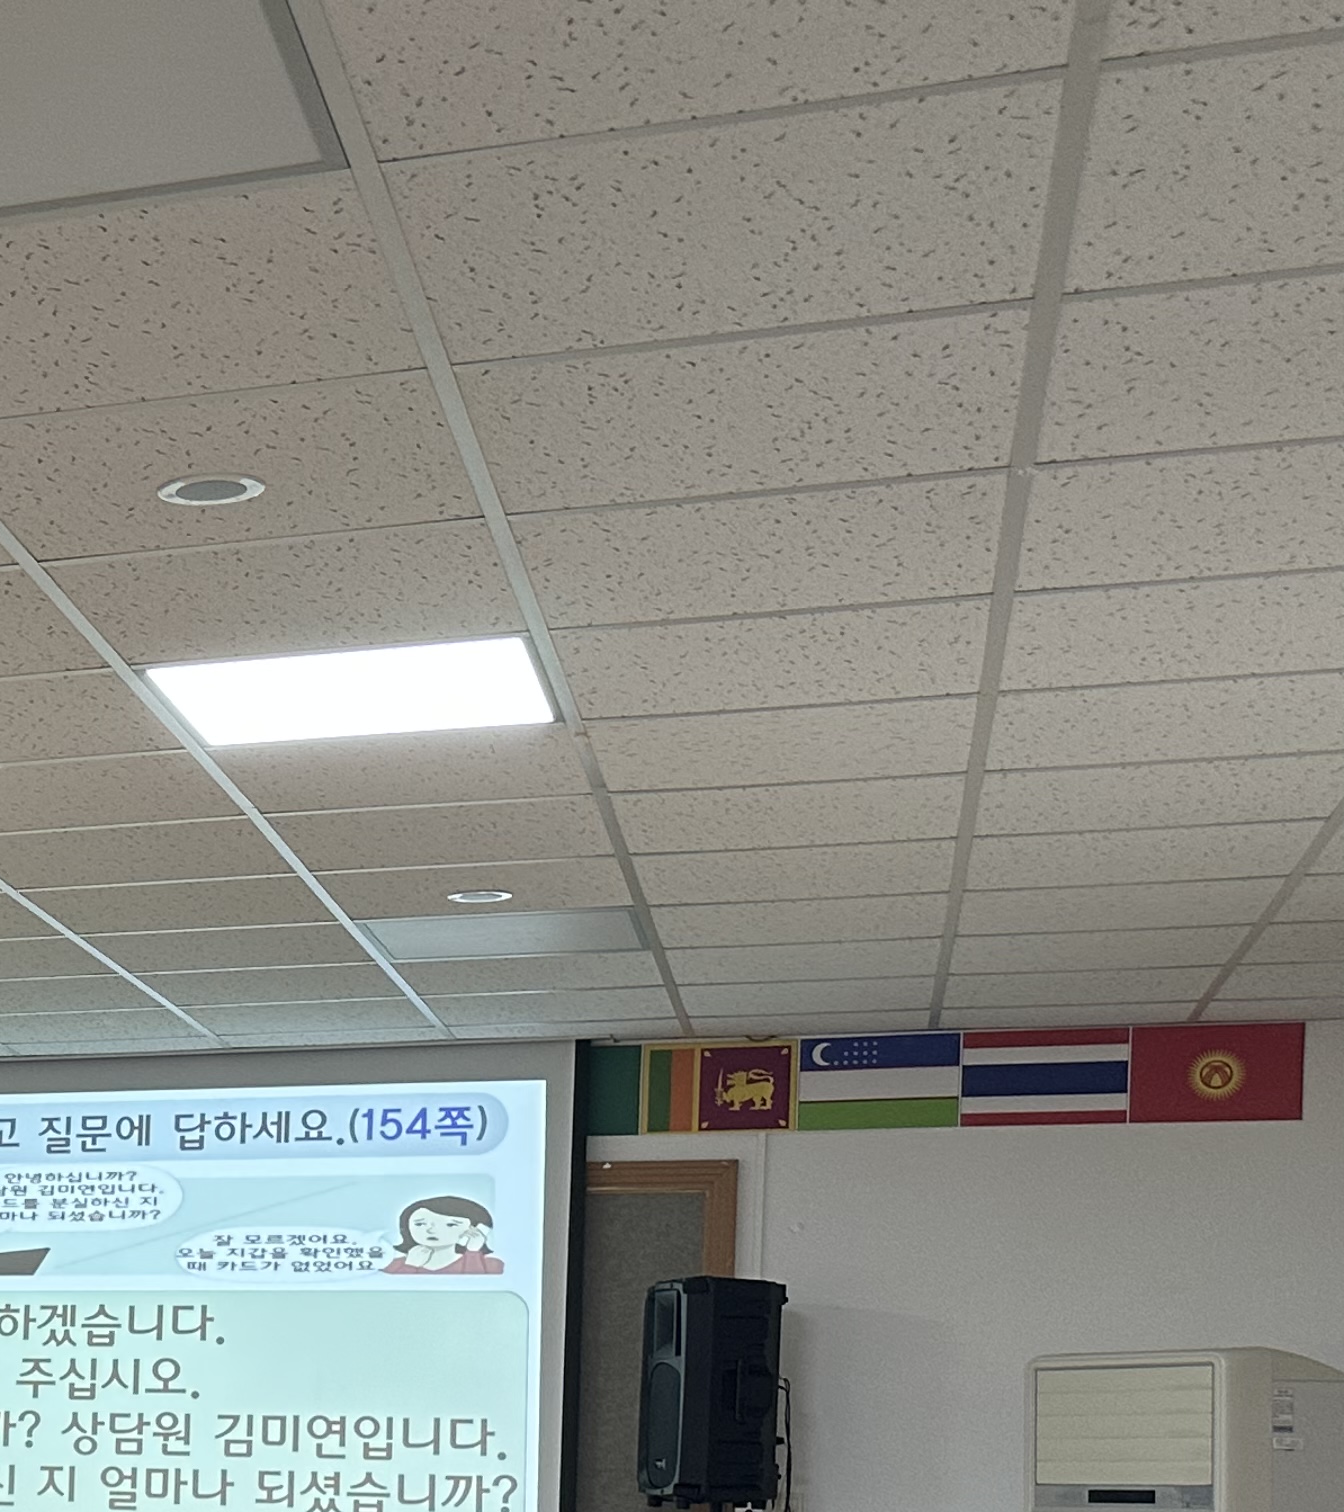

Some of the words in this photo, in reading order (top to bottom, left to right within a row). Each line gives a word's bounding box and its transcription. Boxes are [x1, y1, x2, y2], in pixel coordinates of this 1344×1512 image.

[37, 1113, 152, 1155] 질문에
[3, 1170, 138, 1185] 안녕하십니까?
[37, 1181, 165, 1199] 김미연입니다.
[50, 1196, 130, 1210] 분실하신
[140, 1196, 158, 1207] 지
[47, 1208, 162, 1223] 되셨습니까?
[214, 1234, 234, 1247] 잘
[243, 1233, 358, 1247] 모르겠어요.
[173, 1247, 217, 1262] 오늘
[226, 1246, 289, 1260] 지갑을
[299, 1245, 385, 1260] 확인했을
[186, 1261, 207, 1272] 때
[217, 1261, 281, 1272] 카드가
[15, 1357, 201, 1401] 주십시오.
[60, 1411, 191, 1457] 상담원
[214, 1413, 508, 1461] 김미연입니다.
[36, 1465, 76, 1503] 지
[100, 1465, 235, 1512] 얼마나
